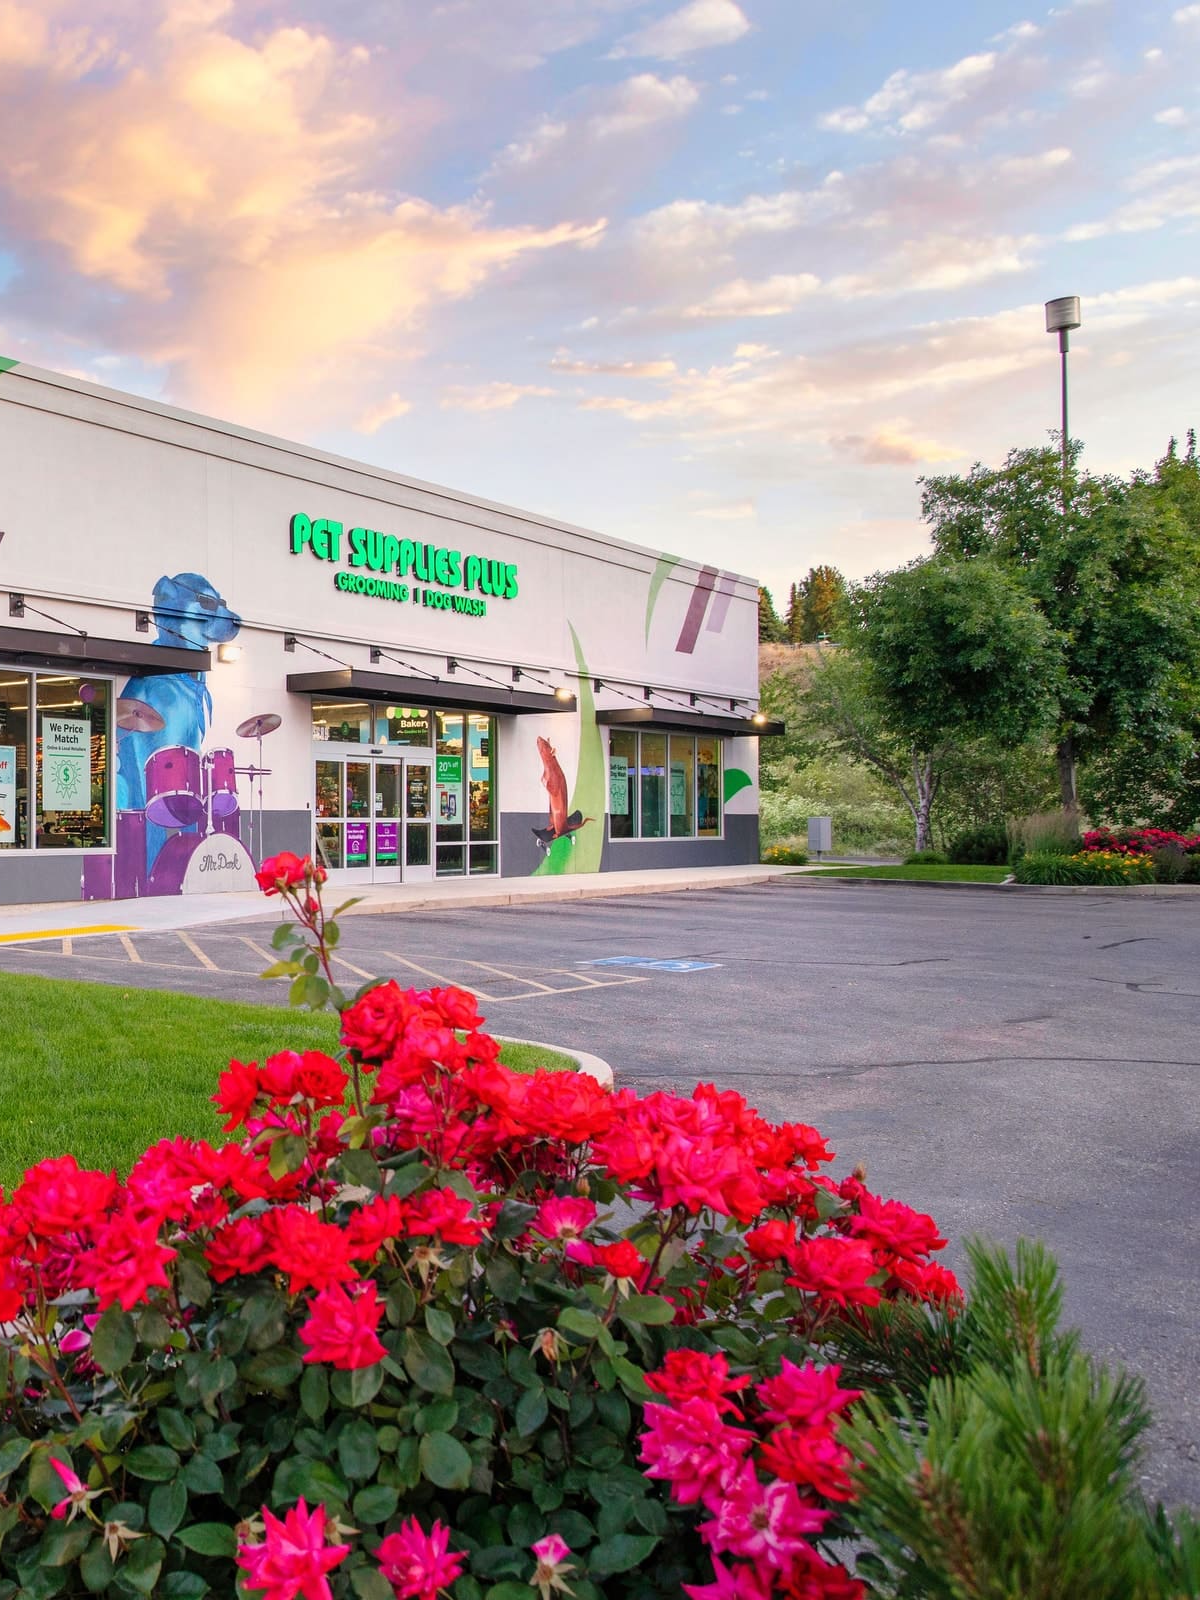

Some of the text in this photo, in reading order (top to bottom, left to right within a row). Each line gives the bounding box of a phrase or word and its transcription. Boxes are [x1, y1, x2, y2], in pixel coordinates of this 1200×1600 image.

[291, 512, 519, 599] PET SUPPLIES PLUS
[335, 572, 487, 617] GROOMING DOG WASH
[49, 722, 84, 734] We Price
[54, 734, 79, 744] Match
